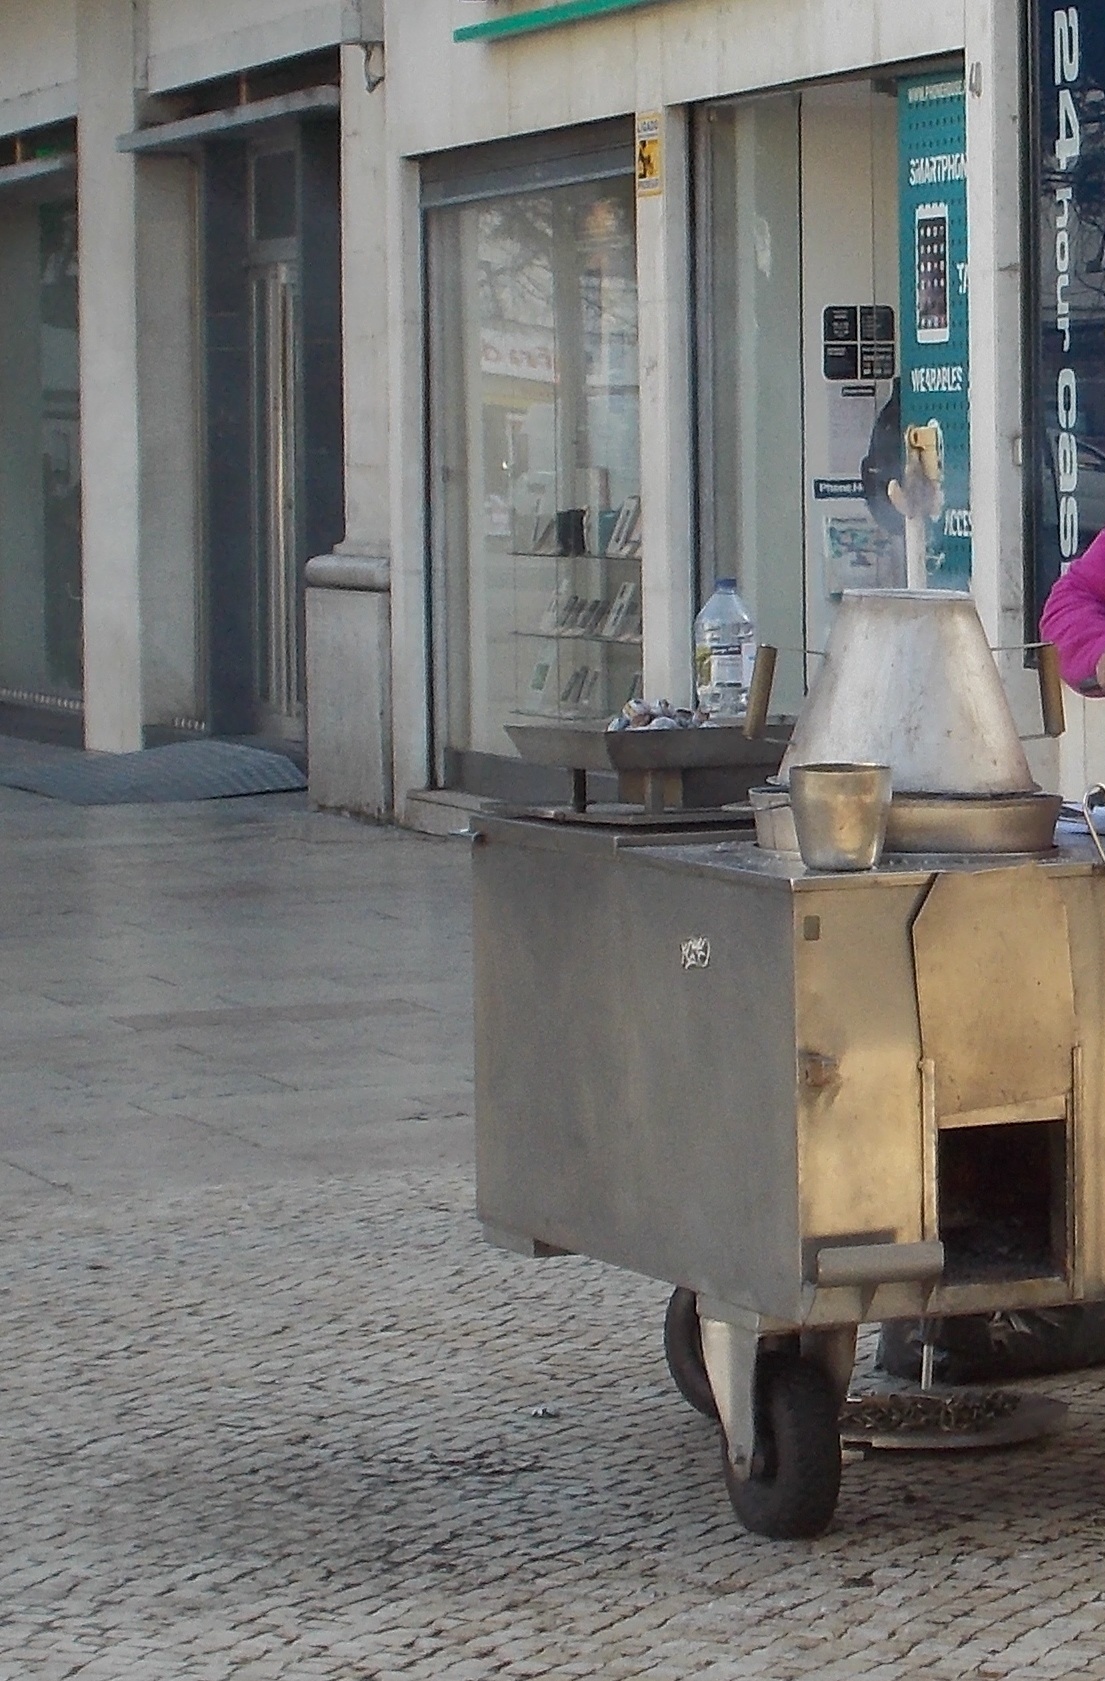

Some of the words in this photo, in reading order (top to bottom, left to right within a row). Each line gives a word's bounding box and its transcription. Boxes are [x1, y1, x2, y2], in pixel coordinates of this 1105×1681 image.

[1054, 7, 1080, 171] 24
[1056, 187, 1072, 352] hour
[911, 366, 963, 392] WEARABLES
